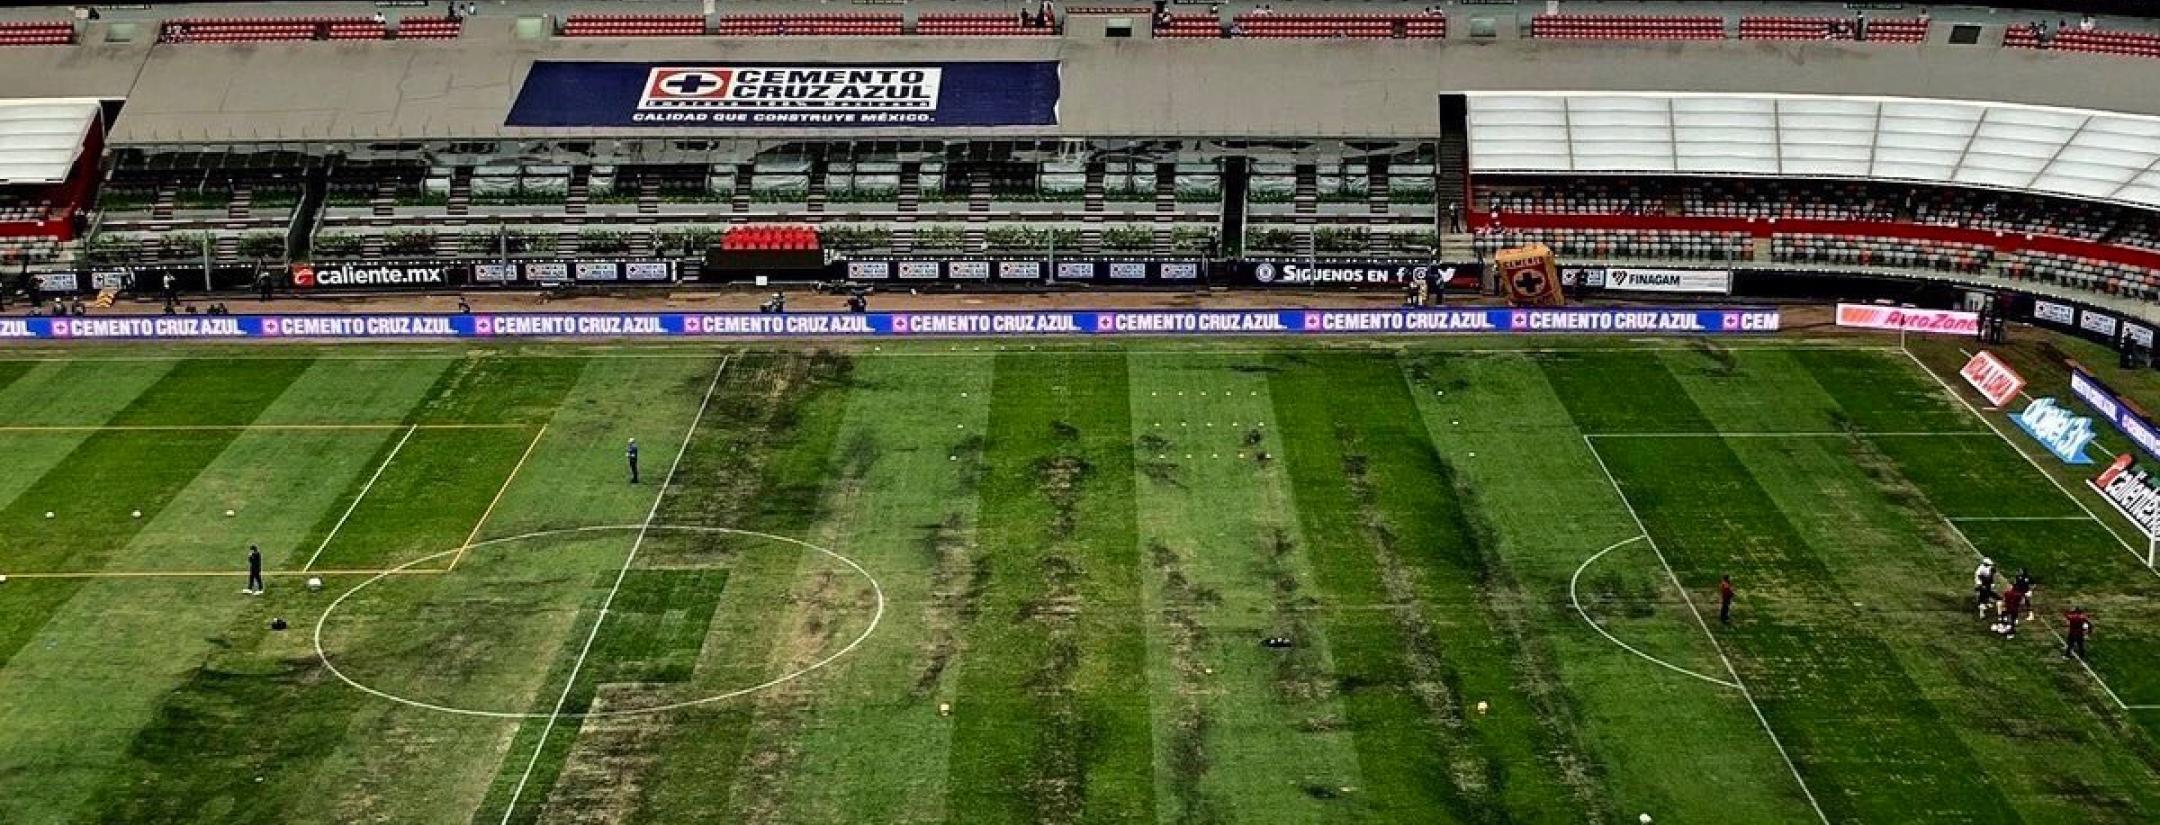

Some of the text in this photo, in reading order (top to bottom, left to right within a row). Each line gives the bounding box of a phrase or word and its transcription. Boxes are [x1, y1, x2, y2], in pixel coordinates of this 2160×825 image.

[738, 71, 924, 83] CEMENTO
[733, 85, 931, 98] CRUZ AZUL
[632, 113, 708, 121] CALIDAD
[713, 113, 748, 121] QUE
[753, 113, 856, 122] CONSTRUYE
[316, 265, 442, 284] caliente.mx
[1367, 269, 1389, 282] EN
[72, 320, 151, 335] CEMENTO
[156, 320, 198, 334] CRUZ
[282, 319, 364, 334] CEMENTO
[367, 318, 409, 333] CRUZ
[495, 318, 576, 332] CEMENTO
[578, 318, 620, 332] CRUZ
[702, 317, 783, 332] CEMENTO
[787, 317, 828, 332] CRUZ
[910, 316, 990, 330] CEMENTO
[993, 316, 1034, 330] CRUZ
[1115, 314, 1195, 329] CEMENTO
[1199, 314, 1240, 330] CRUZ
[1323, 314, 1405, 328] CEMENTO
[1407, 314, 1448, 328] CRUZ
[1530, 314, 1612, 328] CEMENTO
[1615, 314, 1655, 328] CRUZ
